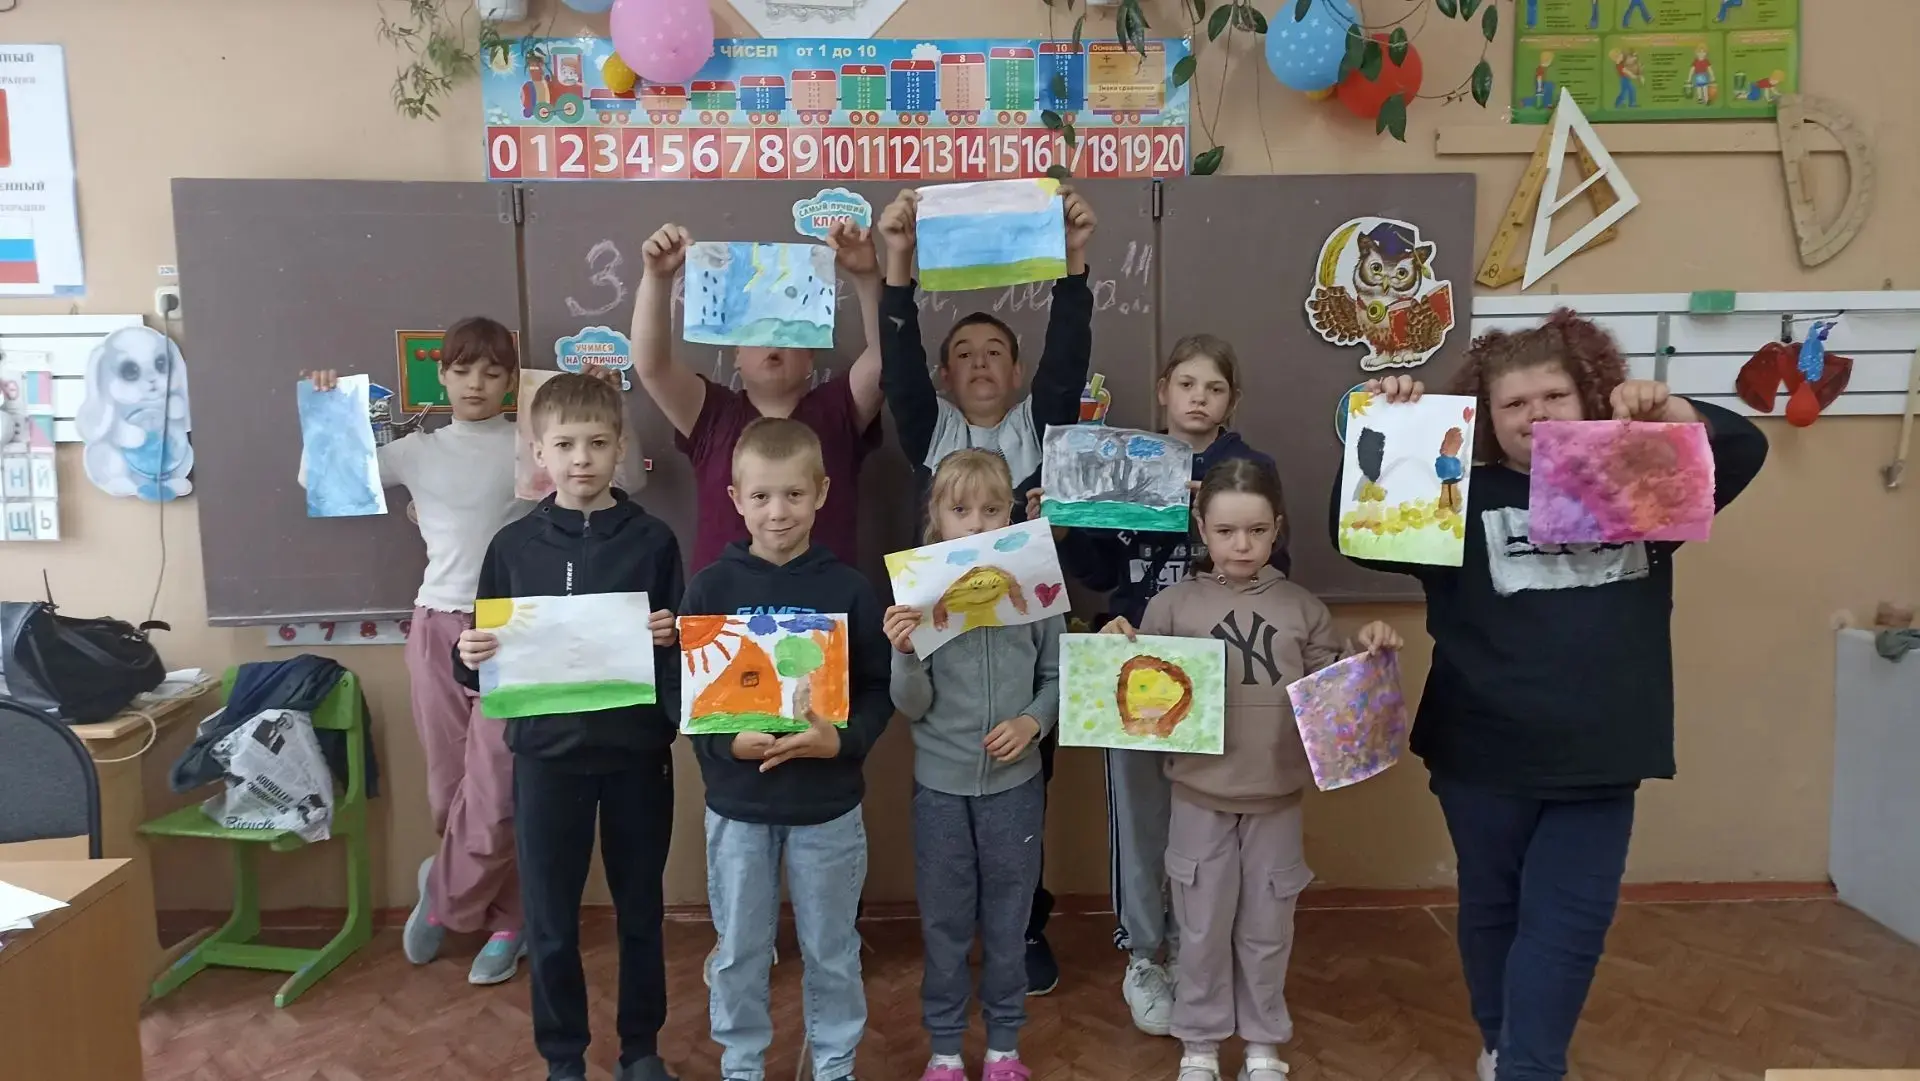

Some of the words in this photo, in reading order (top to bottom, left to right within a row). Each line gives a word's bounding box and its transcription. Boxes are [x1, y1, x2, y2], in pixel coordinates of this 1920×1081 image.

[719, 45, 778, 58] ЧИСЕЛ
[796, 47, 813, 57] от
[818, 44, 826, 57] 1
[832, 47, 852, 59] до
[857, 44, 877, 57] 10
[1008, 48, 1016, 57] 9
[1056, 44, 1068, 52] 10
[959, 54, 966, 63] 8
[860, 66, 867, 74] 6
[910, 61, 916, 70] 7
[810, 71, 817, 79] 5
[710, 81, 717, 90] 3
[759, 77, 766, 86] 4
[660, 86, 667, 95] 2
[492, 135, 518, 172] 0
[530, 134, 548, 172] 1
[560, 134, 586, 173] 2
[594, 134, 618, 173] 3
[625, 134, 653, 173] 4
[660, 135, 685, 173] 5
[692, 135, 719, 173] 6
[726, 136, 751, 173] 7
[758, 135, 785, 173] 8
[792, 135, 818, 173] 9
[823, 135, 854, 173] 10
[858, 136, 886, 173] 11
[890, 136, 921, 173] 12
[922, 135, 954, 173] 13
[956, 136, 986, 173] 14
[989, 136, 1019, 173] 15
[1022, 135, 1051, 173] 16
[1054, 135, 1085, 172] 17
[1087, 135, 1117, 172] 18
[1121, 134, 1153, 172] 19
[1153, 134, 1185, 172] 20
[798, 202, 828, 217] САМЫЙ
[576, 344, 614, 352] УЧИМСЯ
[566, 356, 579, 364] НА
[582, 355, 628, 365] ОТЛИЧНО!
[11, 467, 24, 487] Н
[9, 512, 32, 535] Щ
[566, 560, 574, 591] TERREX
[279, 623, 297, 641] 6
[319, 621, 336, 641] 7
[360, 620, 378, 640] 8
[1210, 609, 1283, 686] NY
